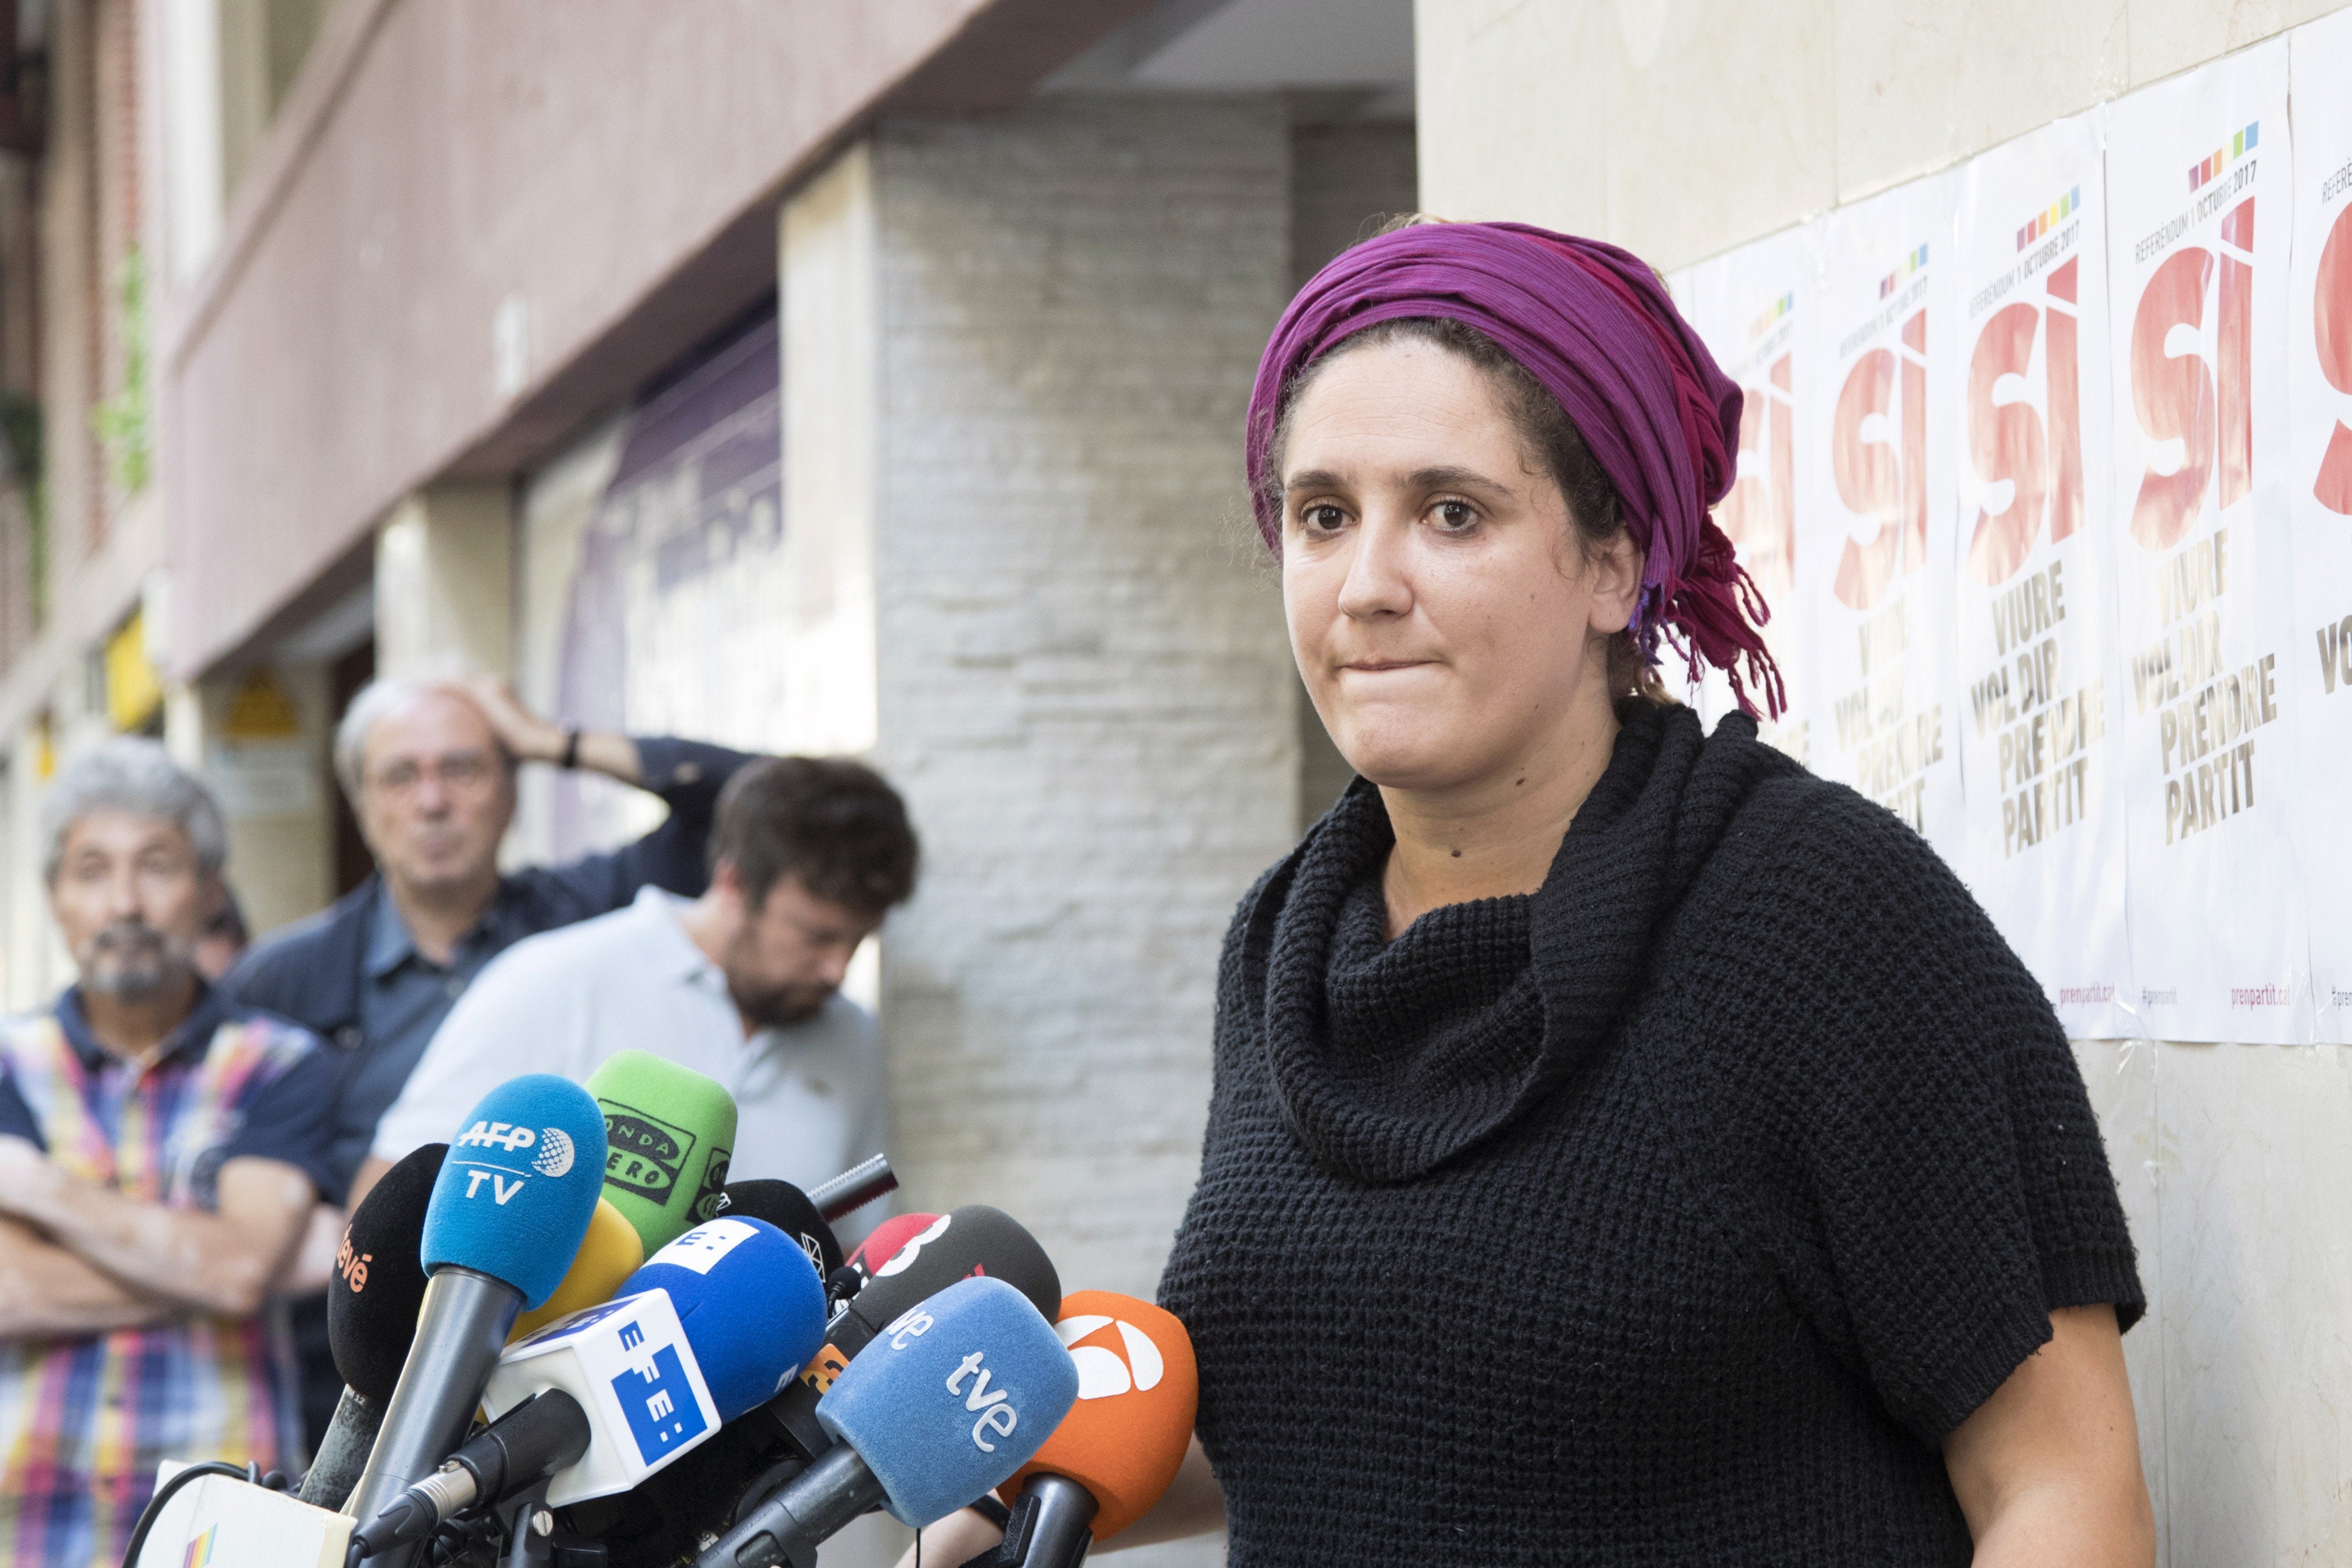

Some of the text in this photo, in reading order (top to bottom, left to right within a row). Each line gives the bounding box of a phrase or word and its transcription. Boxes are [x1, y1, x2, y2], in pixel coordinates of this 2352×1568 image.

[2024, 236, 2059, 280] OCTUBRE
[2061, 219, 2080, 251] 2017
[2135, 159, 2257, 265] REFERÈNDUM 1 OCTUBRE 2017
[1992, 559, 2066, 657] VIURE
[2156, 527, 2229, 628] VIURE
[1971, 665, 2017, 740] VOL
[2131, 610, 2224, 716] VOL DIR
[2160, 653, 2277, 775] PRENDRE
[2002, 755, 2088, 860] PARTIT
[2165, 739, 2254, 846] PARTIT
[2060, 982, 2115, 1009] prenpartit.cat
[2231, 982, 2290, 1010] prenpartit.cat
[457, 1121, 535, 1152] AFP
[465, 1170, 525, 1205] TV
[946, 1352, 1017, 1453] tve
